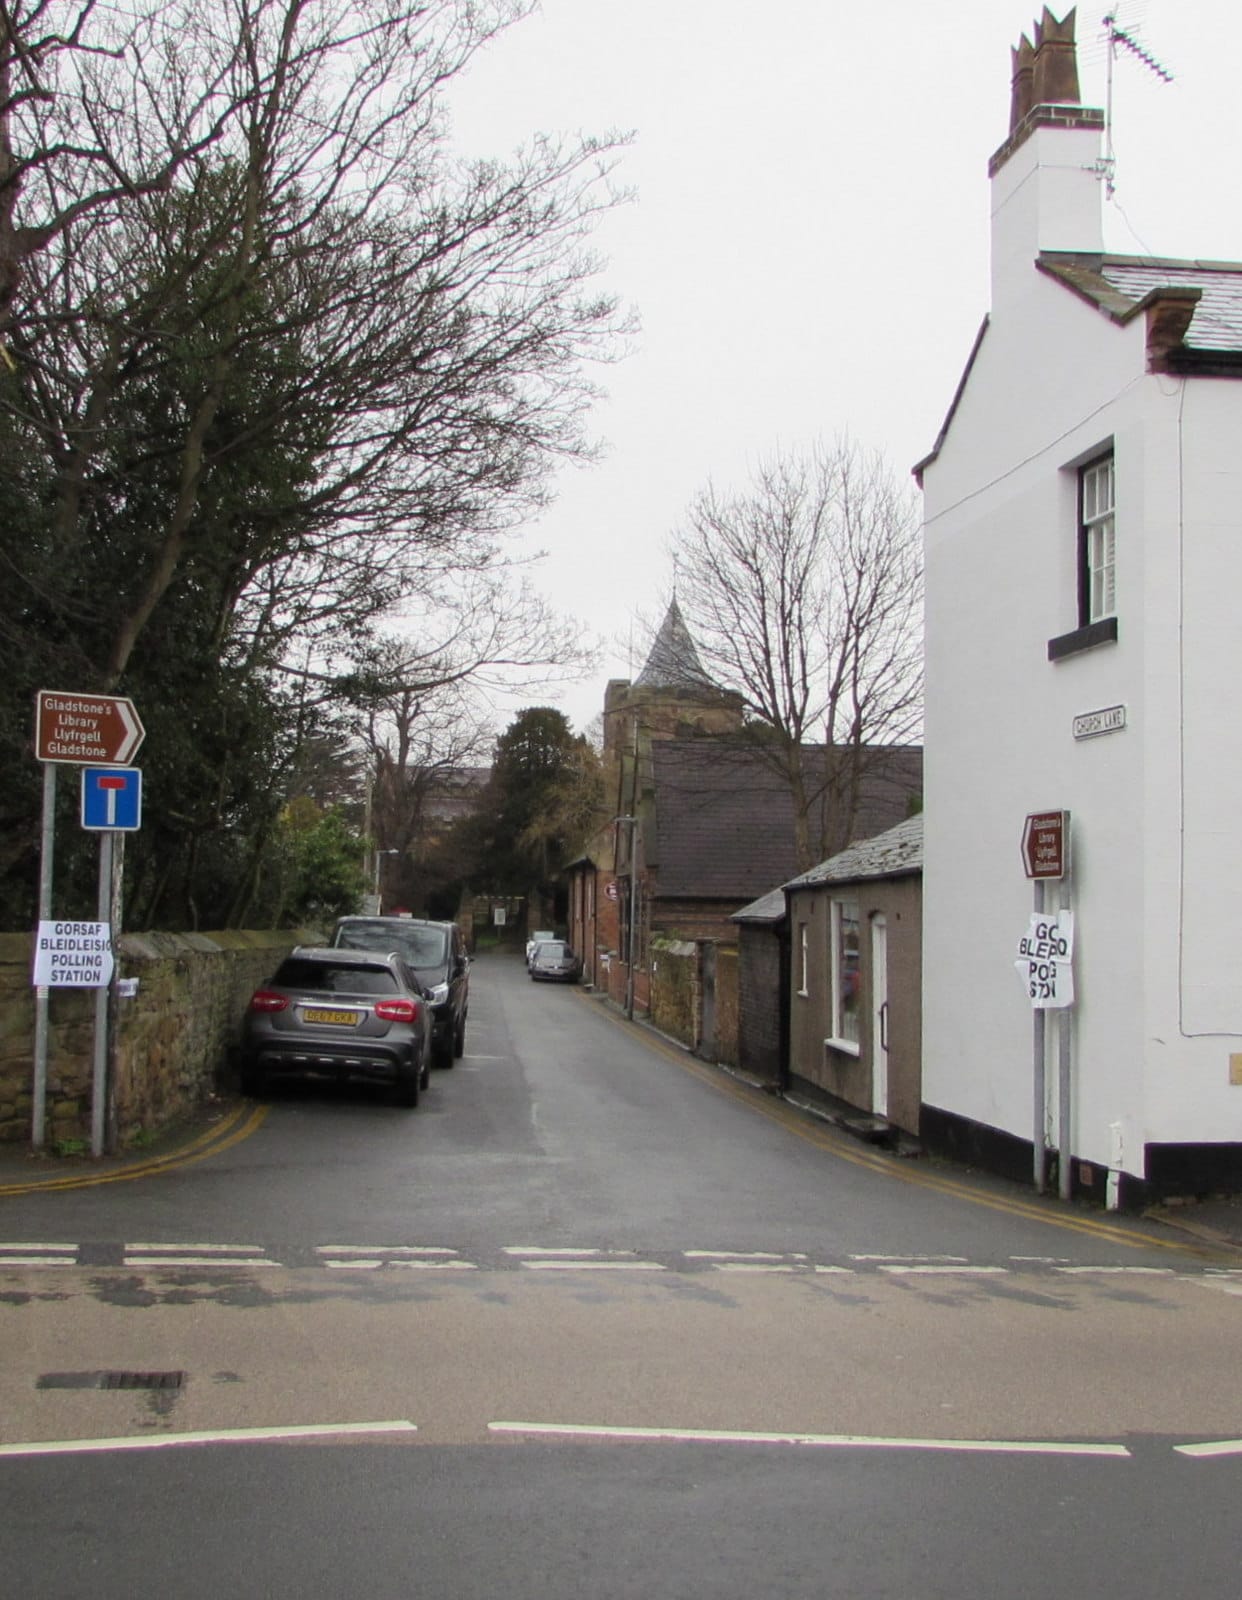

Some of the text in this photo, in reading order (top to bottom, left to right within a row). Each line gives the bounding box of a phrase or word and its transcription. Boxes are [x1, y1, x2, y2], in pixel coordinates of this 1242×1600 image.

[45, 698, 112, 714] Gladstone's
[59, 714, 98, 729] Library
[54, 728, 101, 744] Llyfrgell
[48, 742, 107, 757] Gladstone
[55, 923, 102, 936] GORSAF
[51, 954, 102, 967] POLLING
[51, 970, 101, 983] STATION
